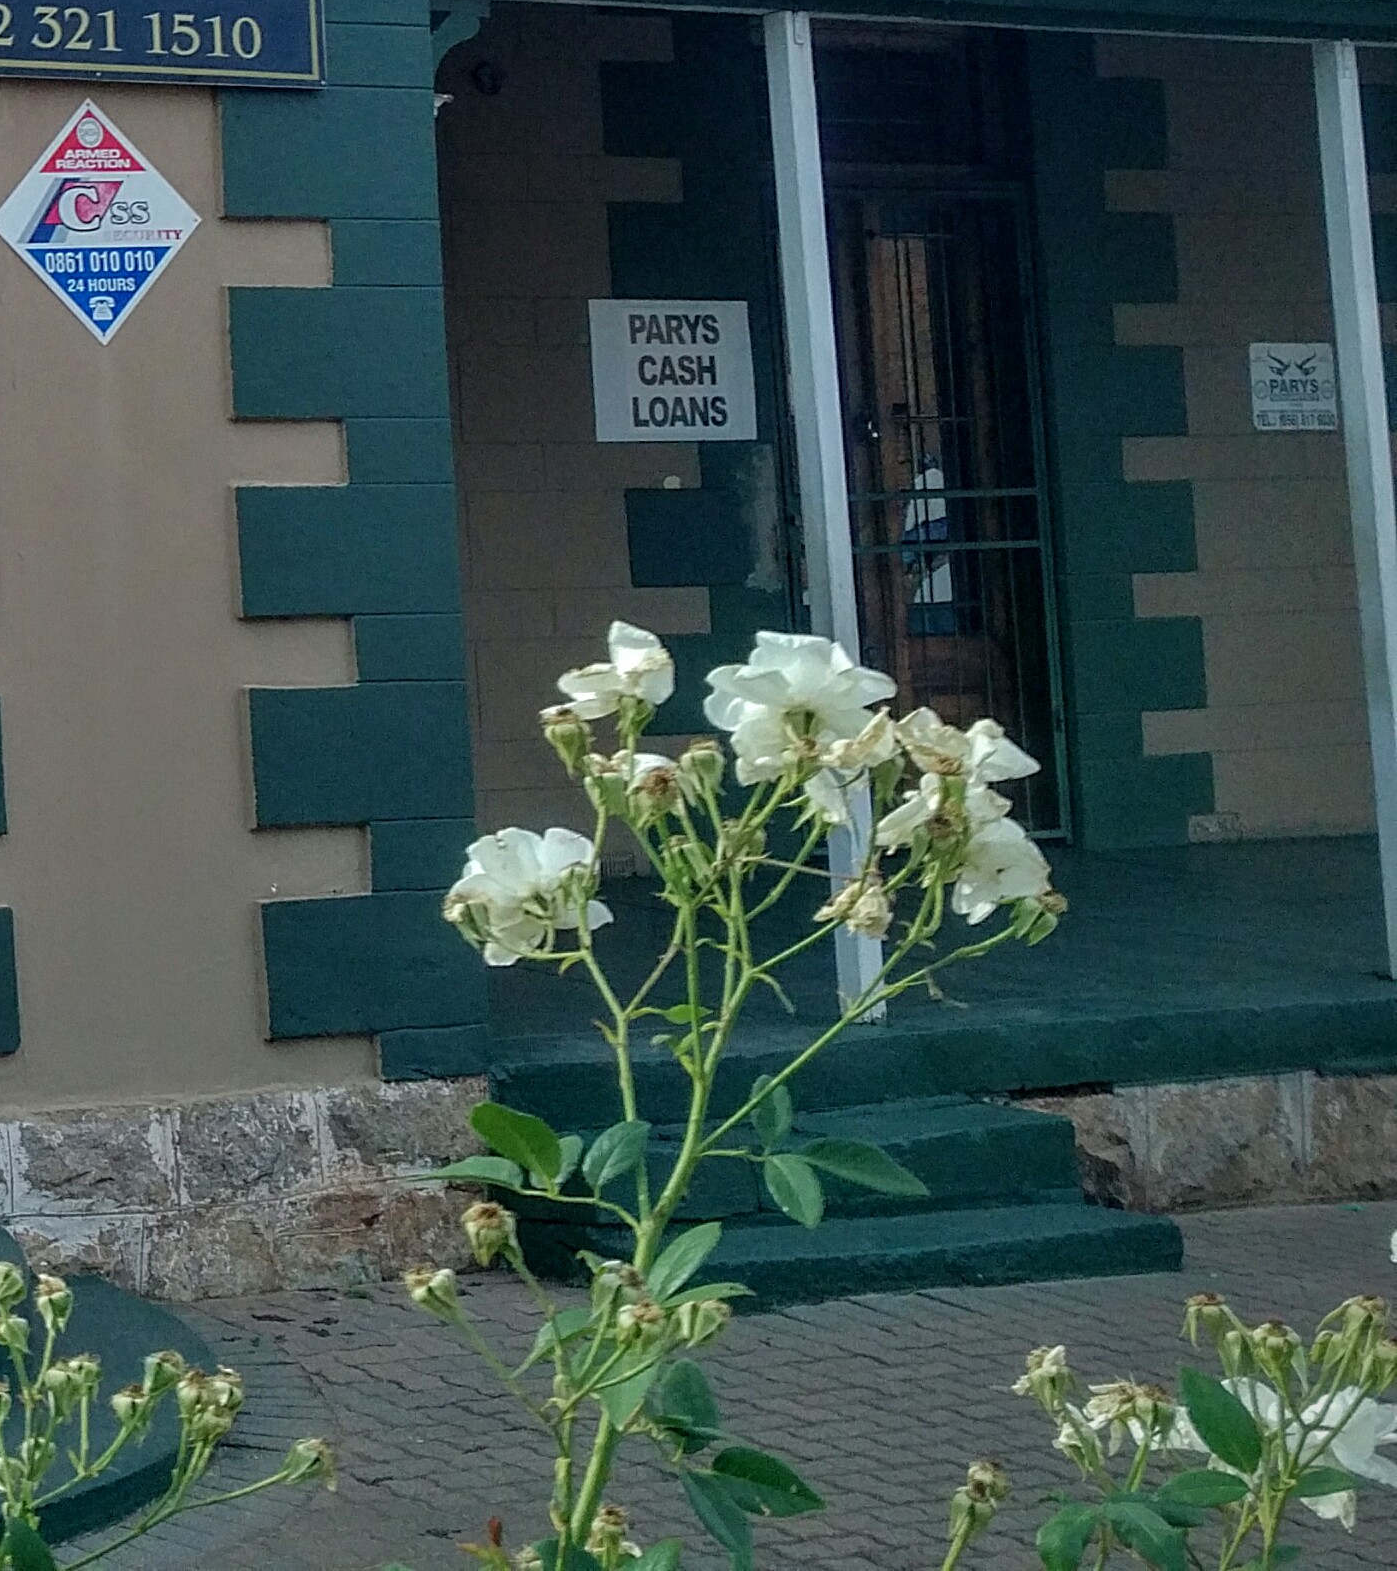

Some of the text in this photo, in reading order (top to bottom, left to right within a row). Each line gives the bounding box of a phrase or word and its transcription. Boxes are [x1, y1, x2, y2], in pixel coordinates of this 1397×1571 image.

[30, 5, 122, 52] 321
[142, 11, 263, 59] 1510
[55, 158, 130, 169] REACTION
[64, 149, 121, 160] ARMED
[110, 229, 183, 241] ECURITY
[45, 249, 155, 274] 0861 010 010
[67, 278, 136, 293] 24 HOURS
[629, 314, 720, 345] PARYS
[638, 355, 717, 386] CASH
[1269, 379, 1319, 394] PARYS
[632, 396, 728, 427] LOANS
